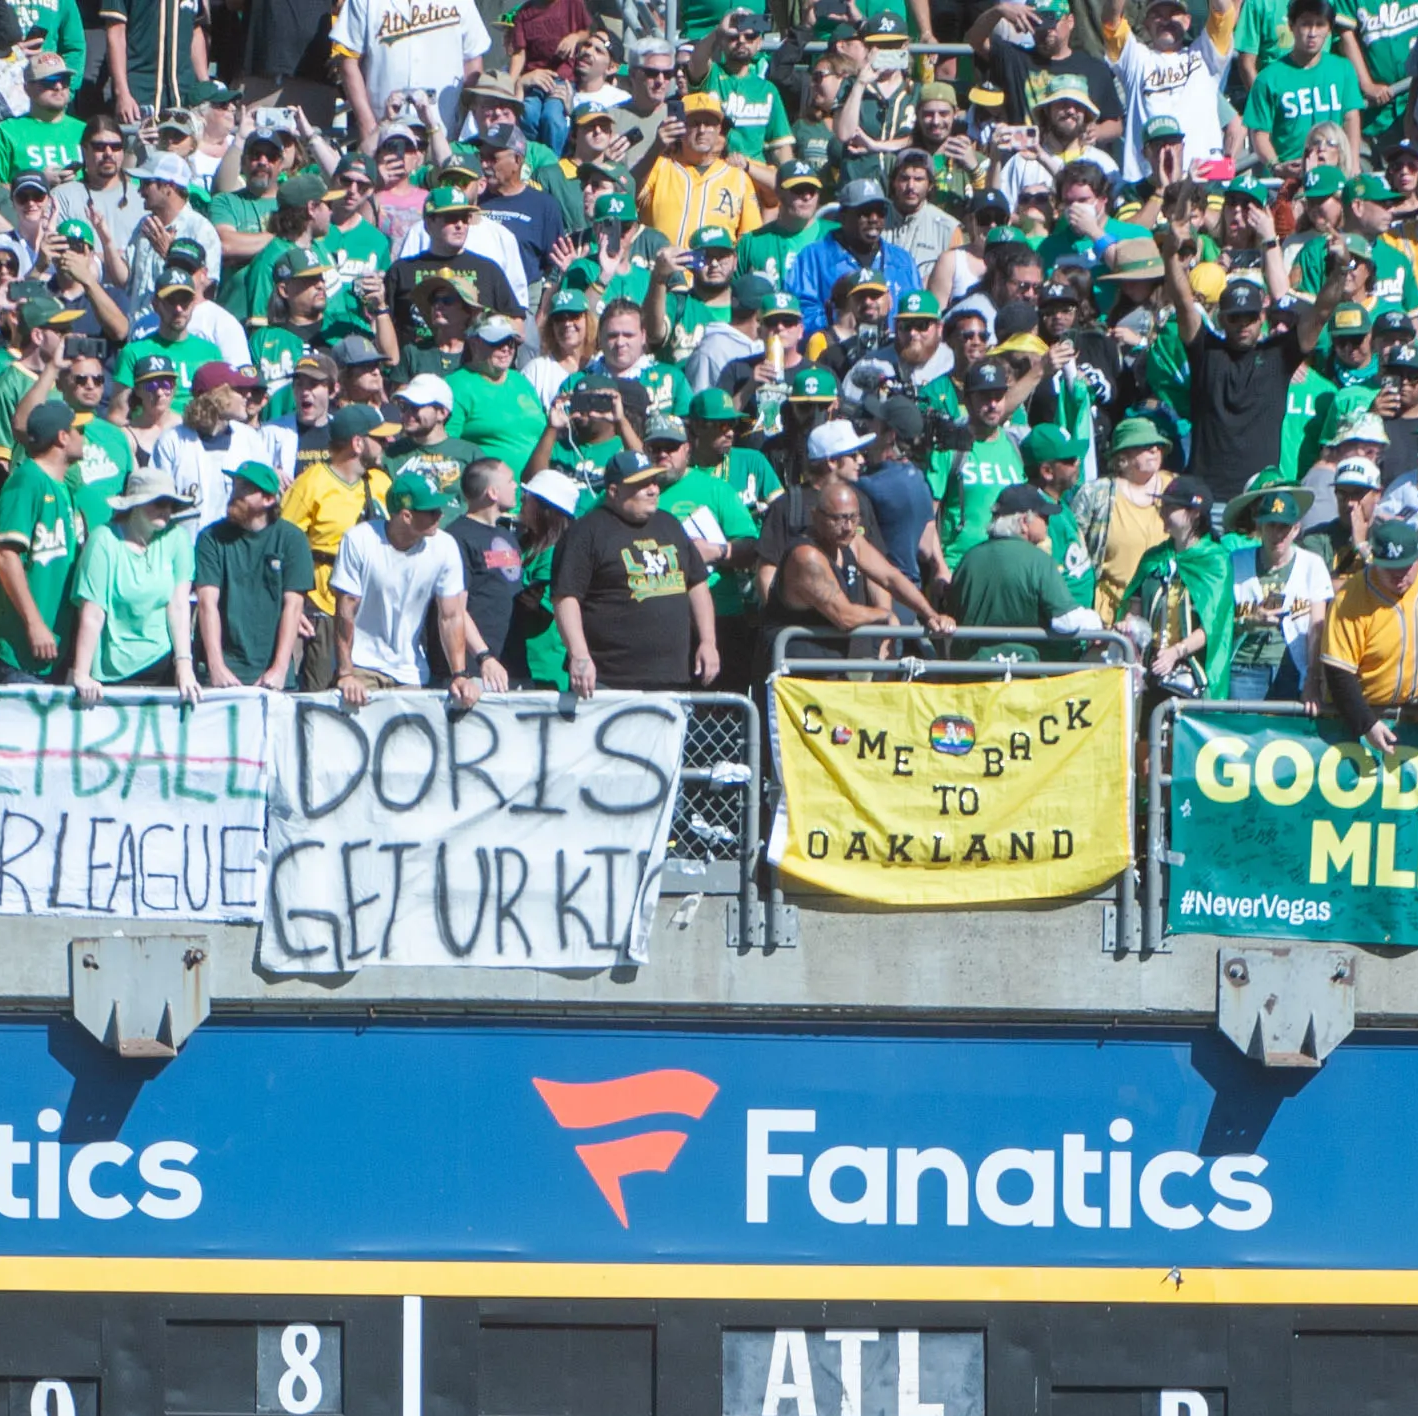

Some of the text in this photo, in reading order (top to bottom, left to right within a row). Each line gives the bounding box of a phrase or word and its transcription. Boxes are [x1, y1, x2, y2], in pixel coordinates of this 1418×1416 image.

[380, 3, 461, 36] Athletics
[1281, 82, 1342, 119] SELL
[1286, 393, 1316, 415] LL
[962, 461, 1023, 485] SELL
[982, 698, 1093, 779] BACK
[296, 700, 678, 819] DORIS
[932, 783, 980, 816] TO
[47, 812, 261, 917] LEAGUE
[807, 829, 1075, 864] OAKLAND
[271, 839, 422, 972] GET
[434, 841, 533, 958] UR
[1180, 889, 1331, 926] #NeverVegas
[746, 1109, 1273, 1231] Fanatics
[277, 1324, 323, 1415] 8
